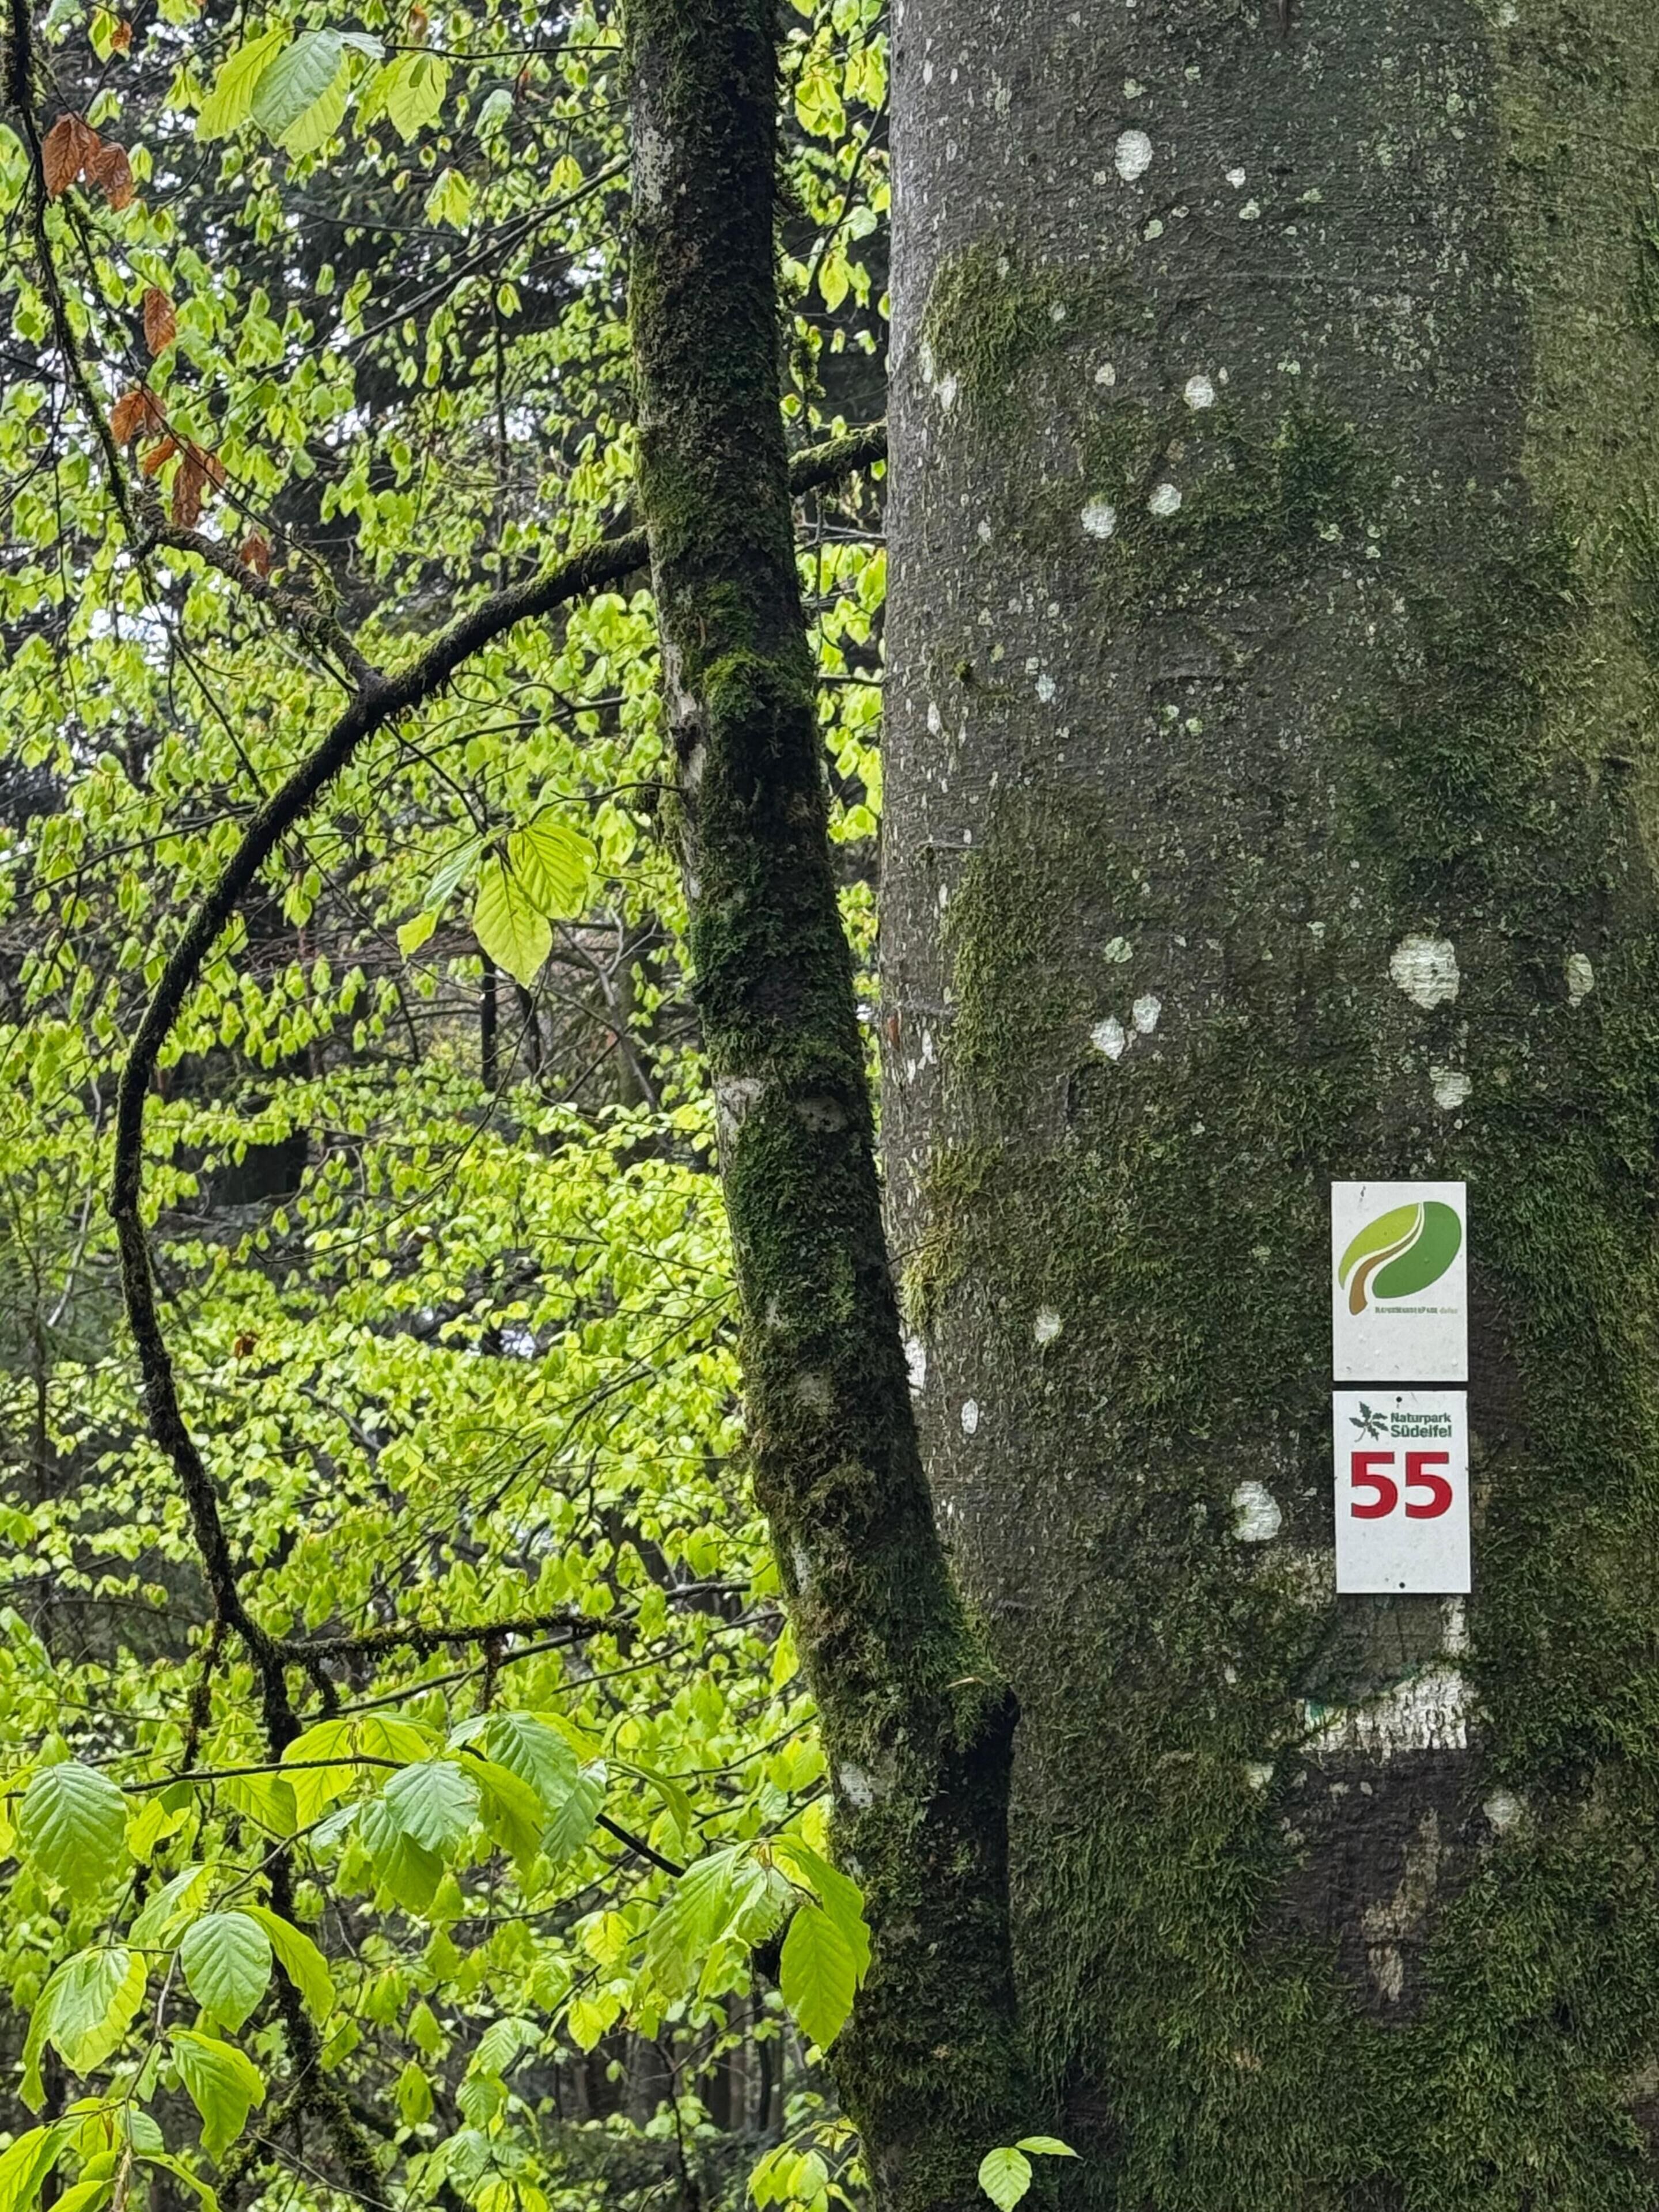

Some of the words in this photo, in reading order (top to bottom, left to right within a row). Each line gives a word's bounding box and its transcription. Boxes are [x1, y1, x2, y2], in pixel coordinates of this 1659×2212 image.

[1391, 1412, 1452, 1425] Naturpark
[1391, 1425, 1452, 1438] Südeifel
[1351, 1451, 1453, 1519] 55
